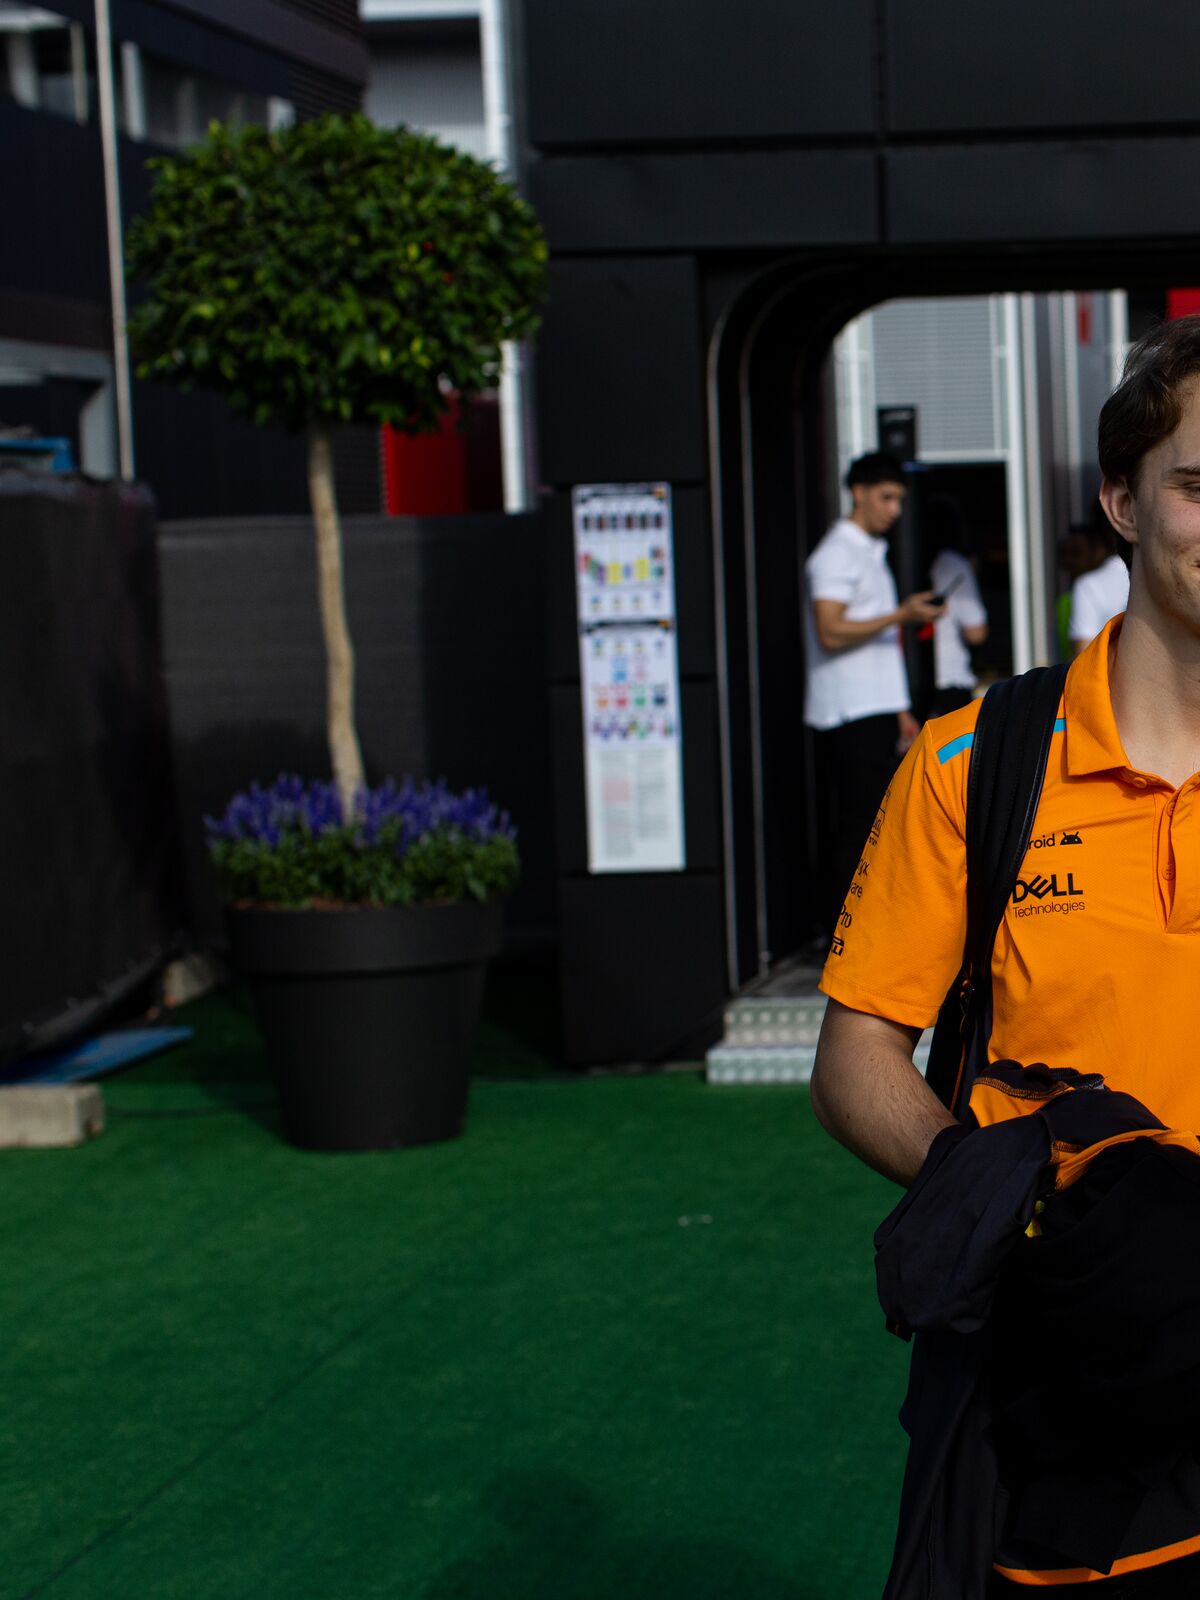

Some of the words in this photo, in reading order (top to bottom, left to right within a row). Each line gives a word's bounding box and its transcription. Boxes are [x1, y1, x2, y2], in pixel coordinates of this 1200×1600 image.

[1028, 833, 1055, 849] roid
[1012, 873, 1084, 904] DELL
[1013, 901, 1086, 919] Technologies
